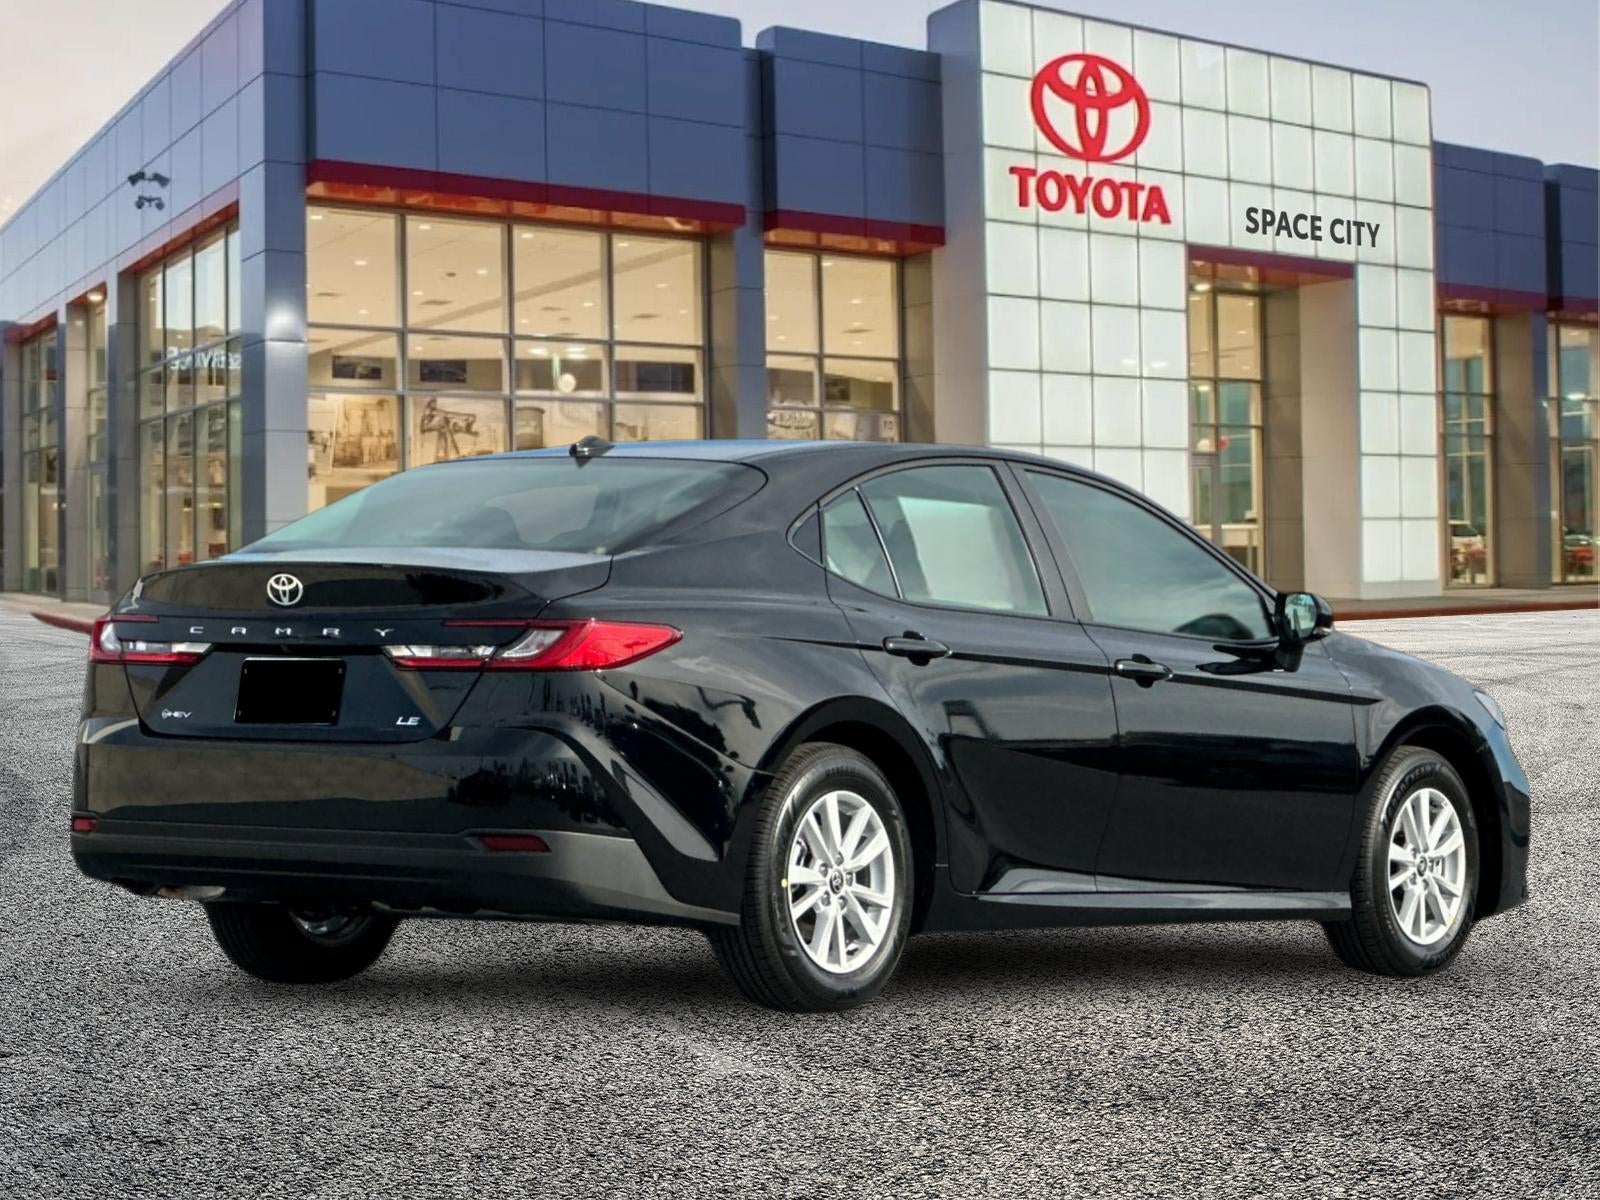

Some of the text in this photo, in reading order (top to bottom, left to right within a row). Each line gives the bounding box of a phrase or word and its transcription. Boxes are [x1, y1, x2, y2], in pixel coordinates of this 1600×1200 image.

[1009, 166, 1171, 224] TOYOTA
[1245, 206, 1381, 248] SPACE CITY
[189, 626, 394, 637] CAMRY
[395, 716, 420, 726] LE
